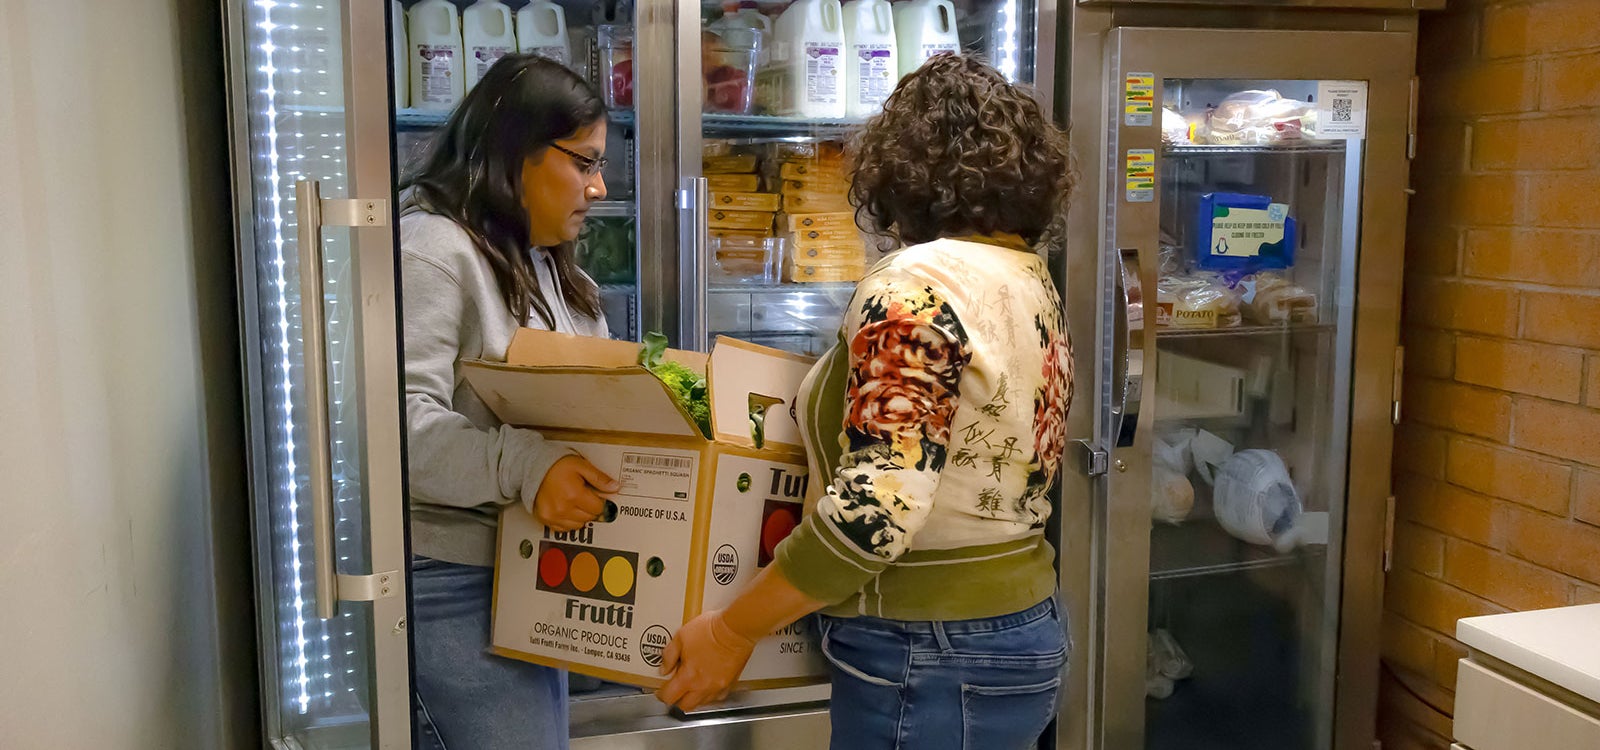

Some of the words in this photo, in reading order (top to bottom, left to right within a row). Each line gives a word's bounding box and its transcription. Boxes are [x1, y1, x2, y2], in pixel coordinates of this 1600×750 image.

[1176, 310, 1214, 319] POTATO
[619, 505, 653, 519] PRODUCE
[654, 508, 665, 520] OF
[665, 510, 687, 522] U.S.A.
[718, 553, 734, 563] USDA
[565, 598, 634, 629] Frutti
[534, 622, 579, 640] ORGANIC
[581, 630, 628, 649] PRODUCE
[646, 632, 667, 645] USDA
[529, 636, 541, 646] Tutti
[541, 638, 554, 648] Frutti
[554, 641, 570, 651] Farms
[570, 644, 580, 653] Inc.
[584, 646, 606, 659] Lompoc,
[606, 651, 614, 659] CA
[779, 641, 804, 654] SINCE
